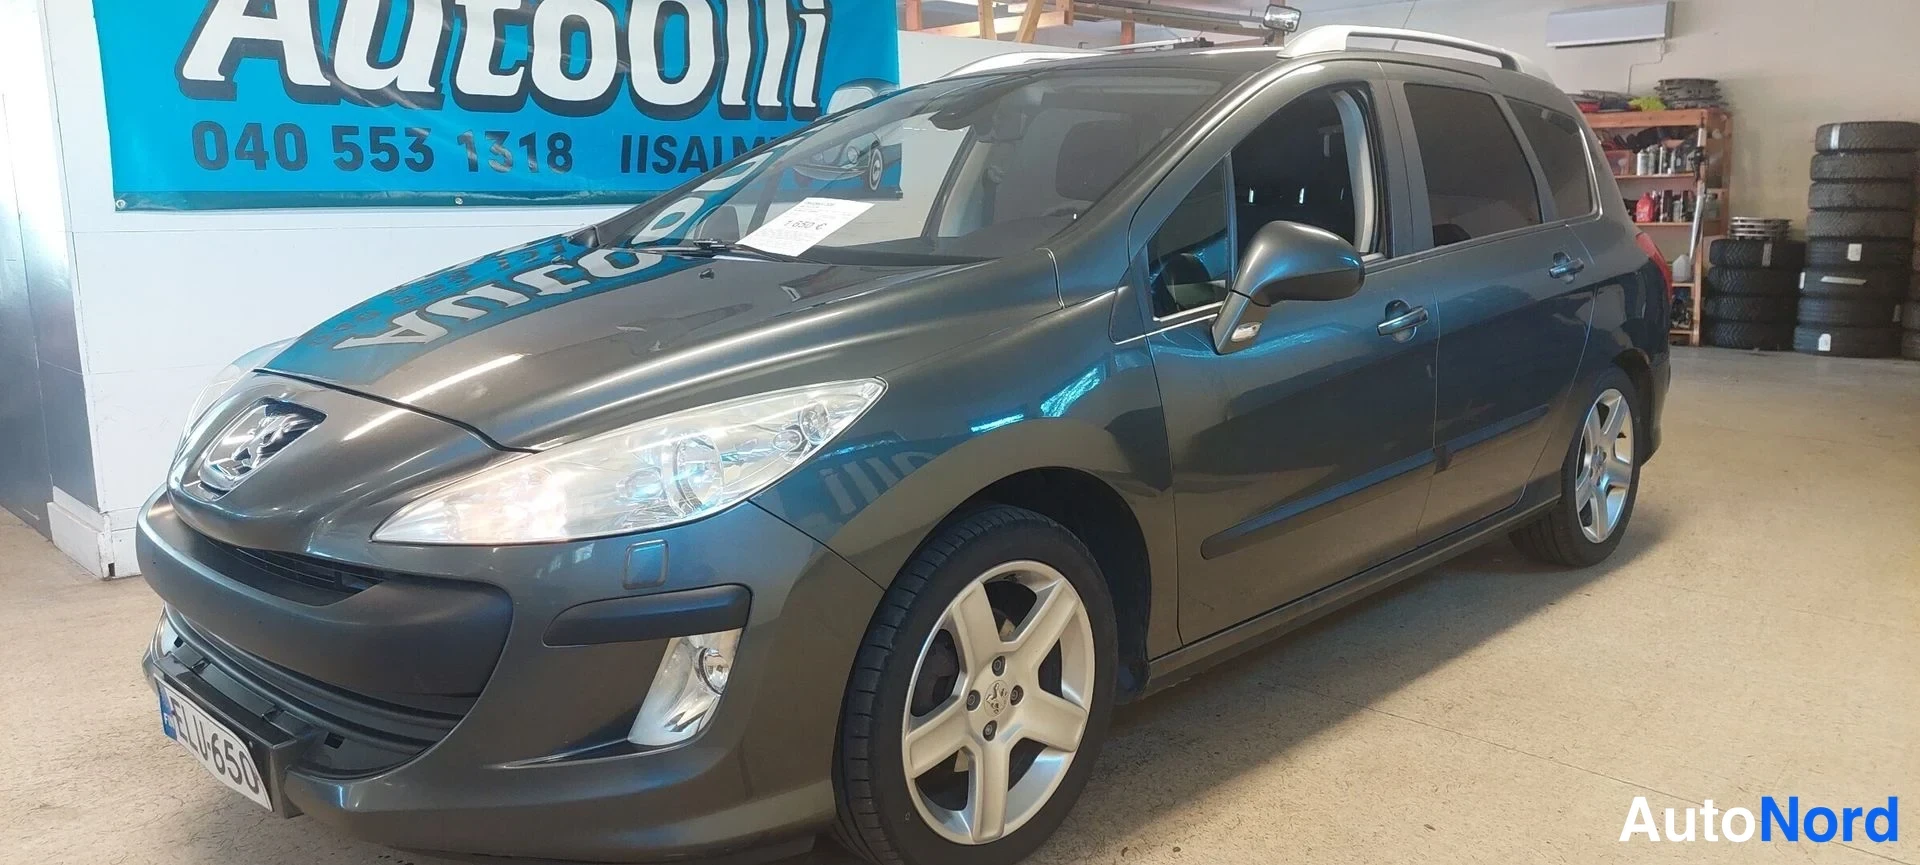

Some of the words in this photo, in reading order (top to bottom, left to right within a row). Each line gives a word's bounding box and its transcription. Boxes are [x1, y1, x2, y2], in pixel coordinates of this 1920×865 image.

[191, 121, 308, 171] 040
[331, 126, 434, 172] 553
[456, 130, 573, 173] 1318
[170, 695, 260, 795] ELU-650
